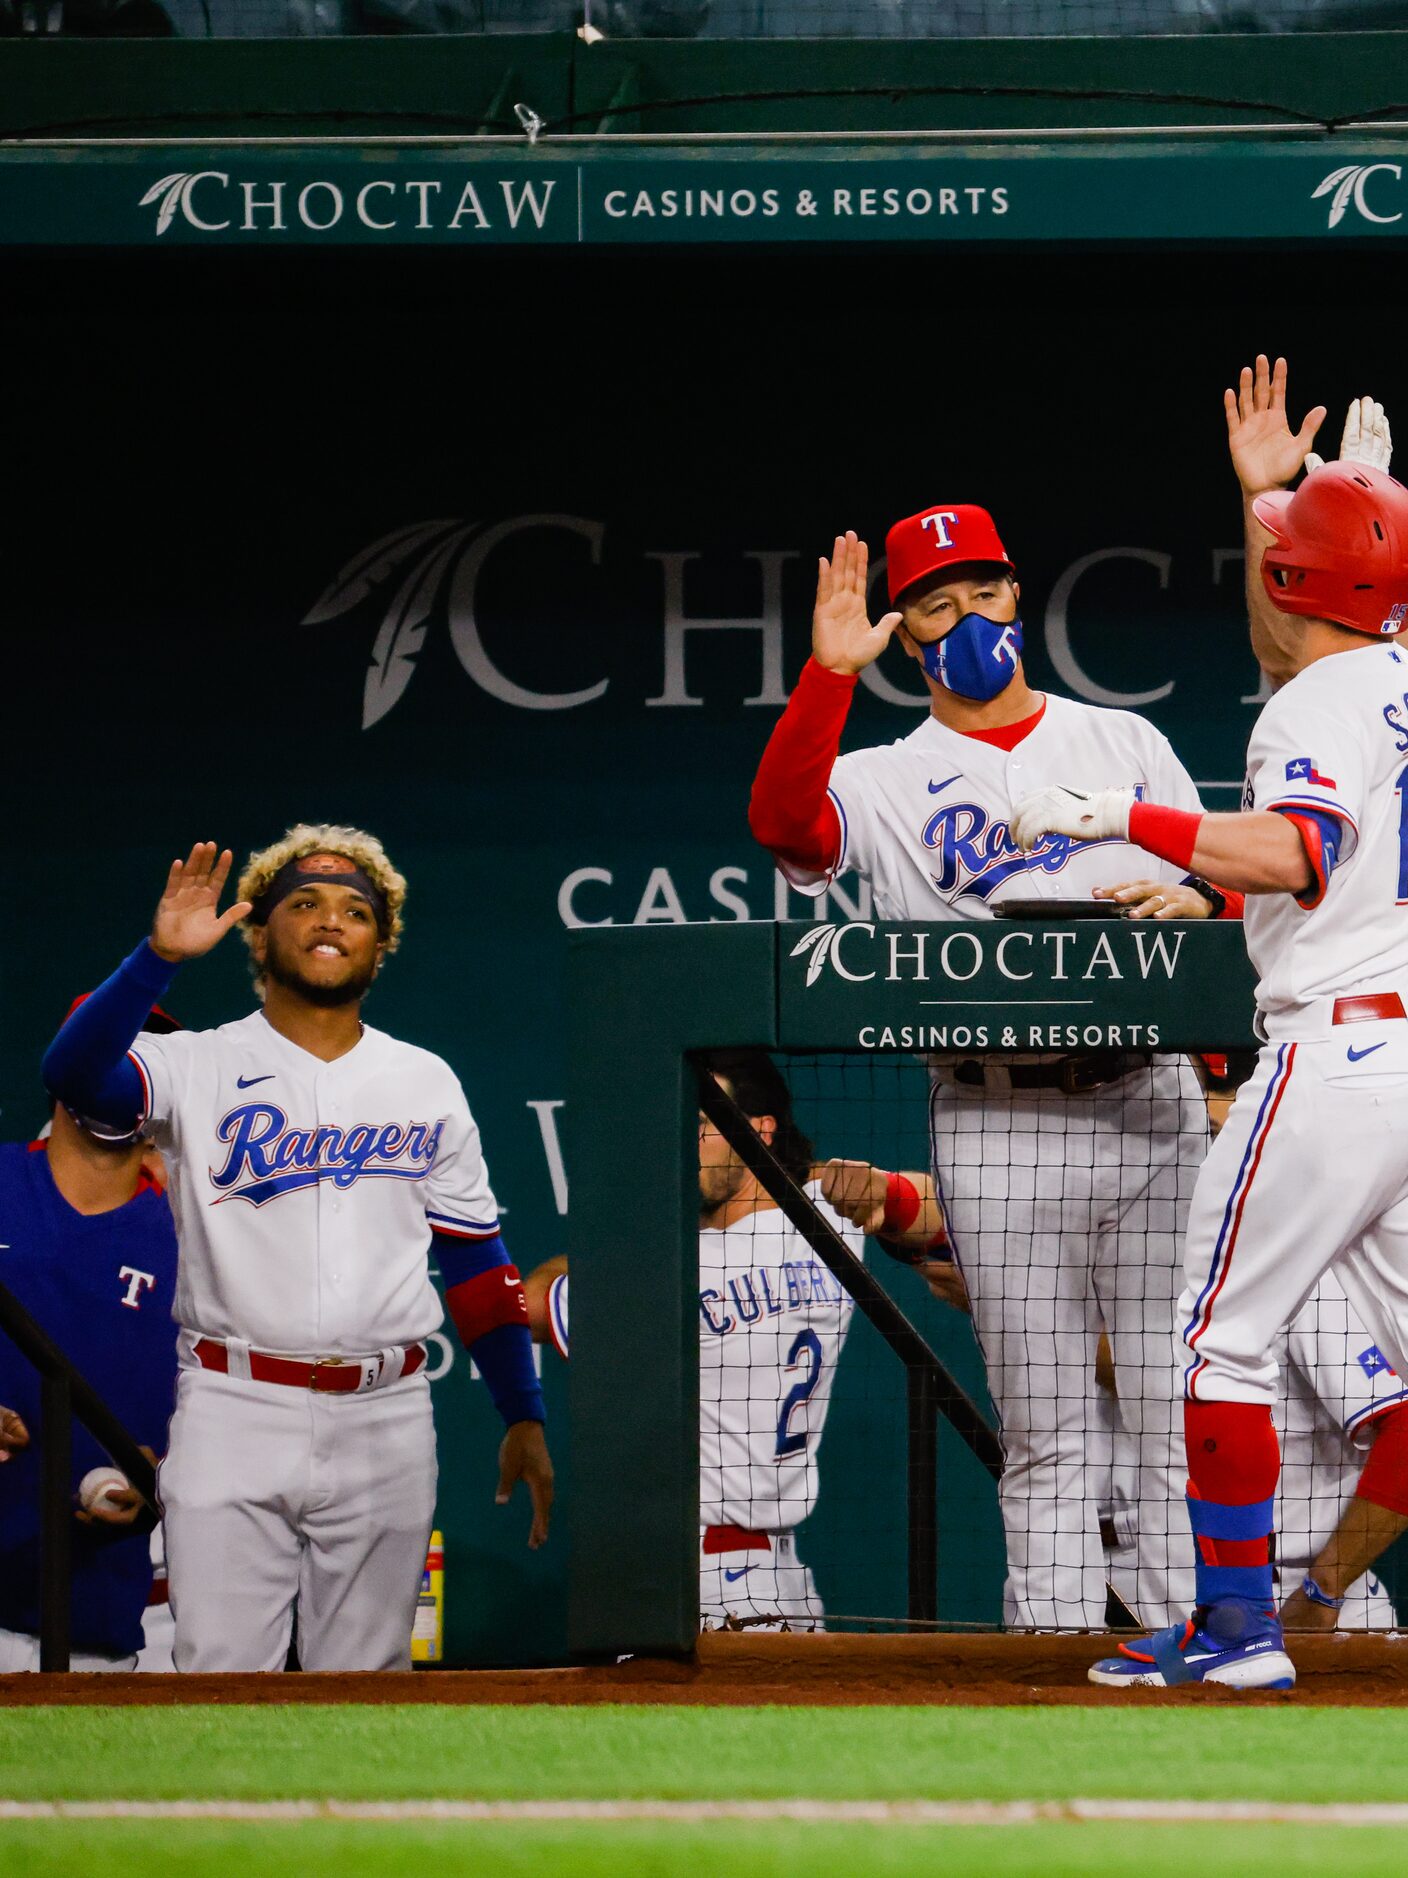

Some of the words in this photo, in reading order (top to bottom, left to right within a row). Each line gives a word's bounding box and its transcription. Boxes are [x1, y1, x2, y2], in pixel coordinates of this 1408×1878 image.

[181, 171, 556, 231] CHOCTAW
[603, 189, 780, 218] CASINOS
[795, 189, 818, 217] &
[833, 187, 1010, 216] RESORTS
[920, 511, 959, 549] T
[830, 922, 1187, 982] CHOCTAW
[858, 1026, 989, 1047] CASINOS
[1000, 1026, 1018, 1047] &
[1028, 1024, 1160, 1047] RESORTS
[208, 1101, 448, 1209] Rangers
[118, 1265, 156, 1310] T
[366, 1368, 375, 1387] 5
[772, 1327, 824, 1463] 2
